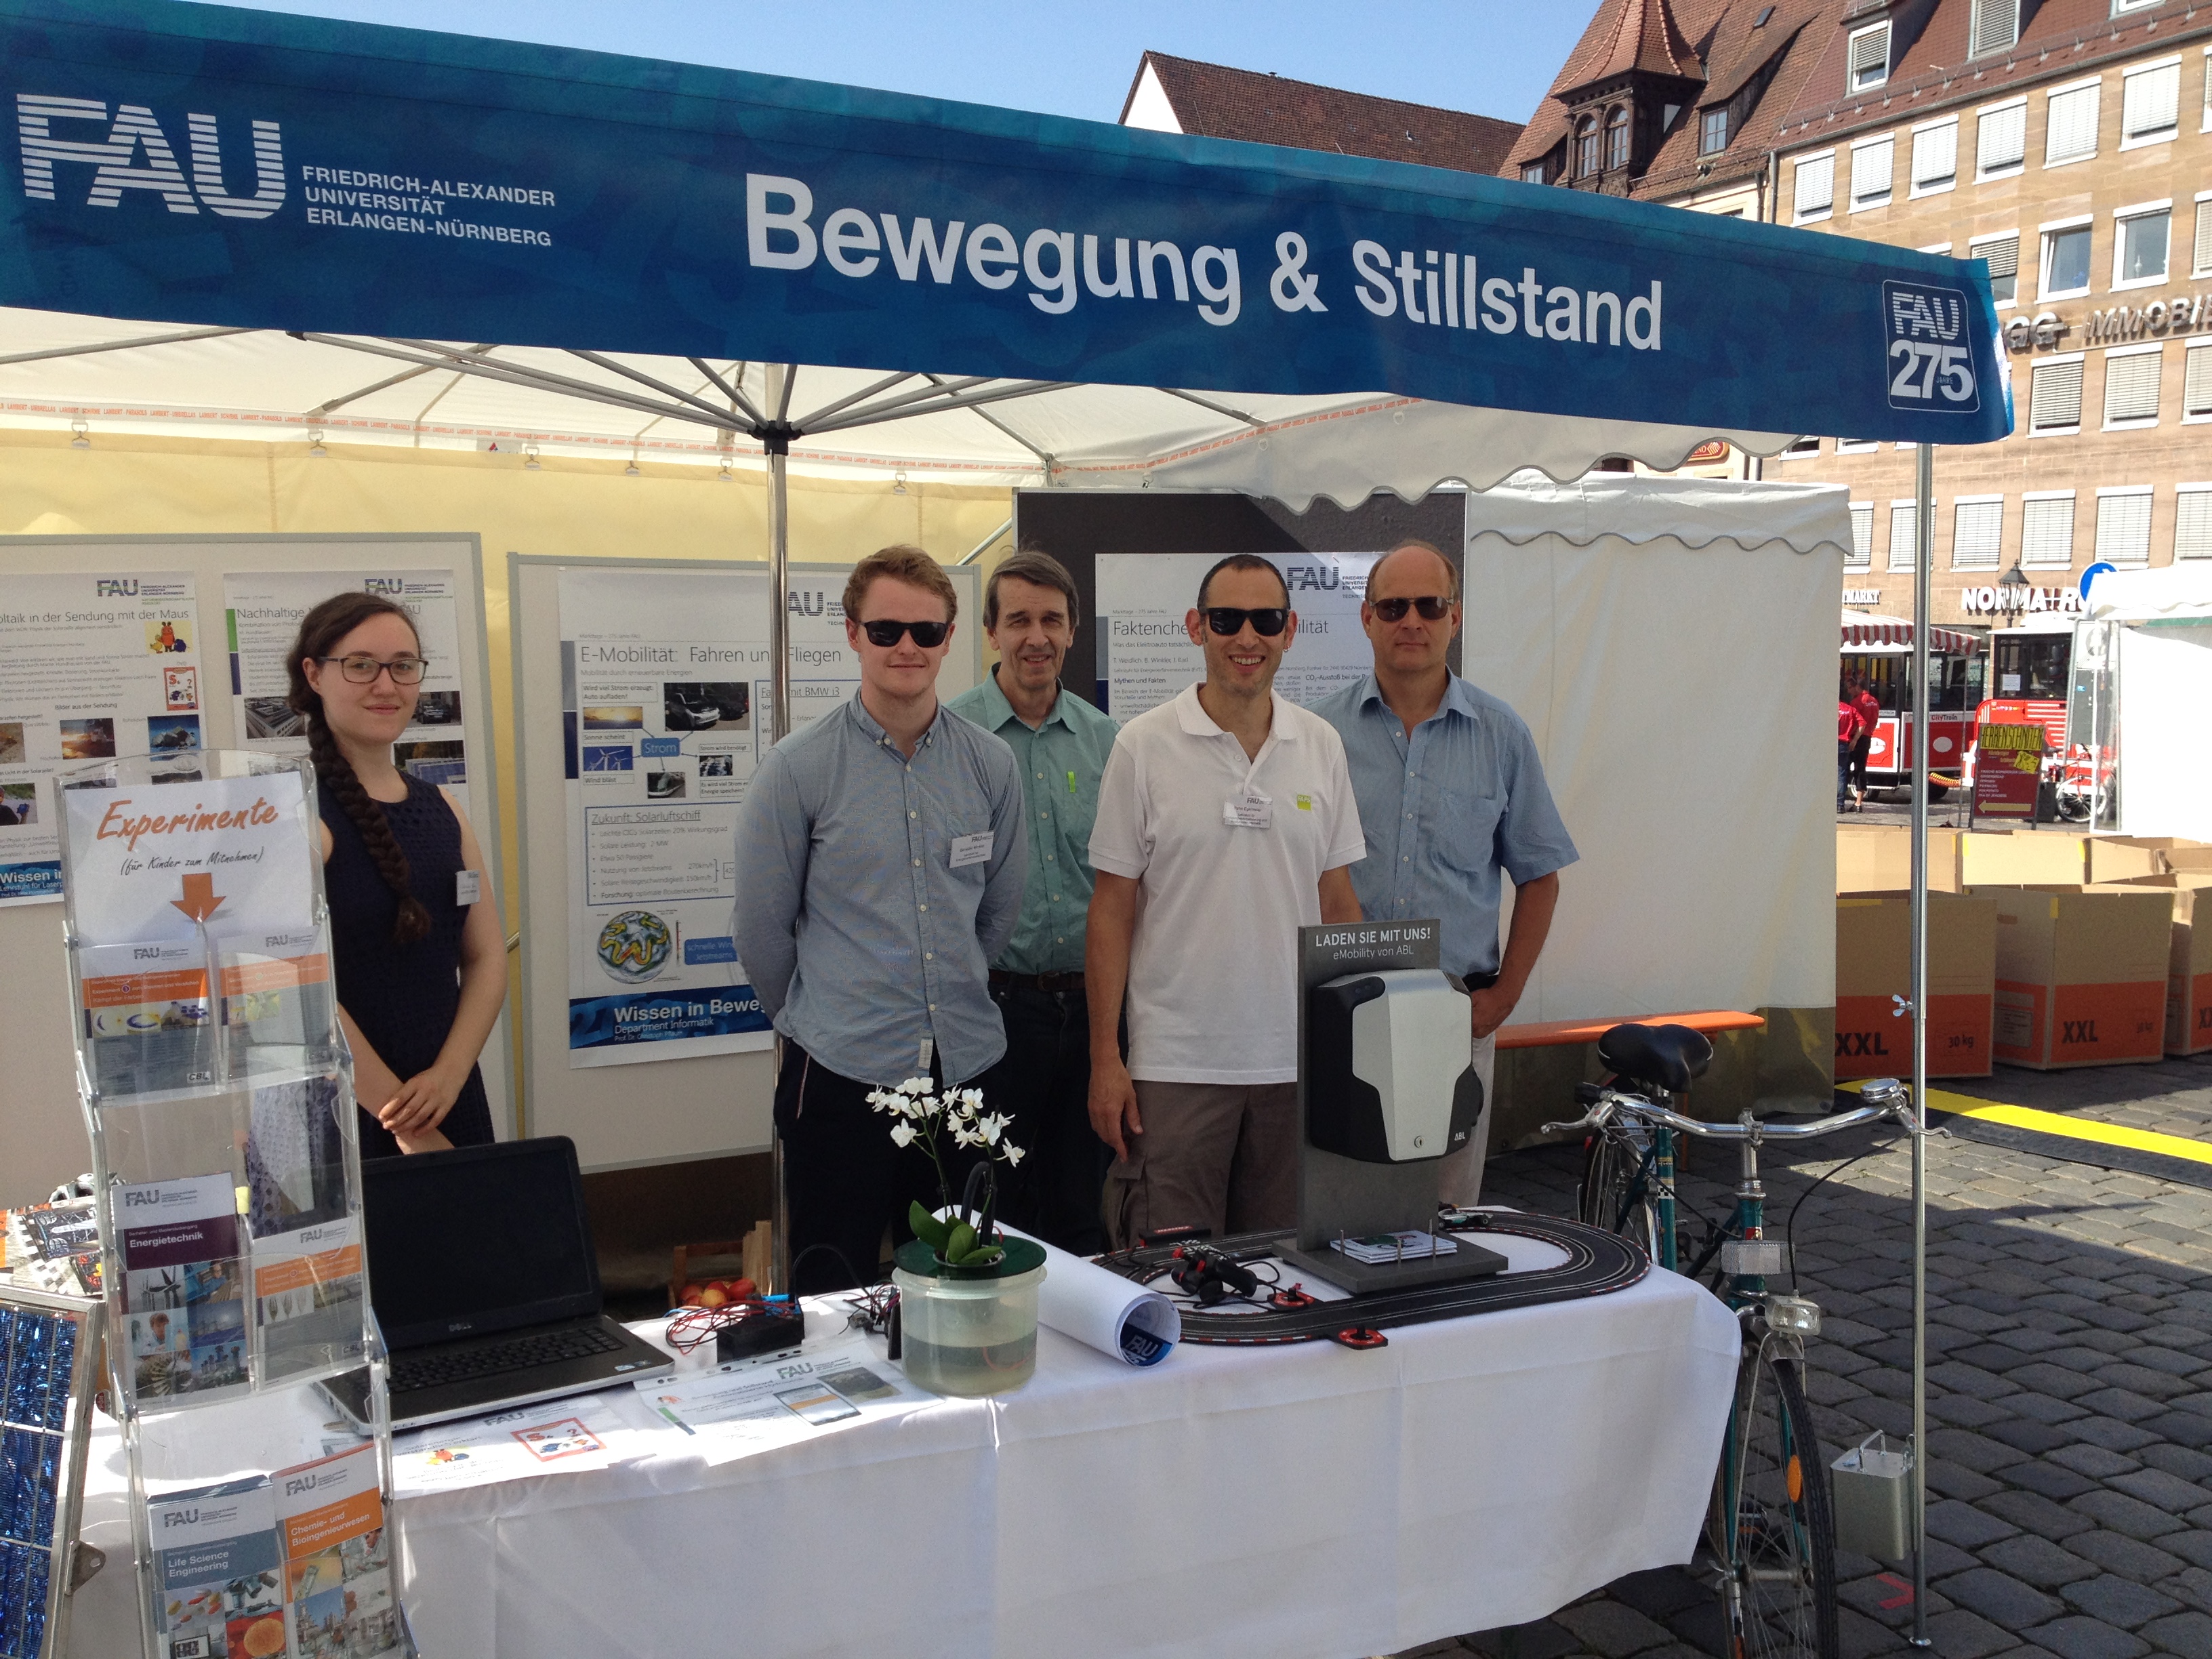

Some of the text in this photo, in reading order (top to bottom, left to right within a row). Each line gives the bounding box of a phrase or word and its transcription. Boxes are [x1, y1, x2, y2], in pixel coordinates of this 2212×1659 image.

[17, 94, 285, 218] FAU
[303, 166, 554, 207] FRIEDRICH-ALEXANDER
[306, 187, 445, 215] UNIVERSITÄT
[307, 208, 551, 247] ERLANGEN-NÜRNBERG
[747, 173, 1661, 350] Bewegung & Stillstand
[1893, 292, 1959, 340] FAU
[1889, 340, 1973, 401] 275
[365, 579, 402, 594] FAU
[1287, 567, 1339, 590] FAU
[97, 579, 138, 596] FAU
[788, 592, 823, 616] AU
[1961, 586, 2047, 610] NORMA
[43, 613, 62, 622] der
[66, 611, 114, 623] Sendung
[118, 611, 135, 620] mit
[139, 610, 157, 619] der
[160, 610, 189, 619] Maus
[237, 608, 304, 619] Nachhaltige
[581, 647, 678, 662] E-Mobilität:
[690, 647, 743, 662] Fahren
[805, 687, 829, 696] BMW
[644, 743, 676, 753] Strom
[96, 797, 279, 852] Experimente
[636, 810, 701, 822] Solarluftschiff
[148, 857, 181, 869] Kinder
[0, 872, 50, 883] Wissen
[266, 935, 288, 947] FAU
[1316, 928, 1431, 947] LADEN SIE MIT UNS!
[134, 947, 159, 959] FAU
[1333, 945, 1414, 960] eMobility von ABL
[614, 1005, 682, 1023] Wissen
[688, 1002, 703, 1016] in
[615, 1018, 714, 1035] Department Informatik
[2062, 1020, 2098, 1044] XXL
[1835, 1032, 1889, 1056] XXL
[1454, 1132, 1465, 1141] ABL
[125, 1190, 159, 1206] FAU
[129, 1231, 203, 1248] Energietechnik
[300, 1229, 322, 1243] FAU
[1126, 1334, 1158, 1356] FAU
[777, 1362, 814, 1379] FAU
[483, 1412, 525, 1426] FAU
[285, 1475, 316, 1496] FAU
[164, 1509, 199, 1528] FAU
[291, 1520, 327, 1536] Chemie-
[330, 1511, 345, 1523] und
[292, 1514, 370, 1546] Bioingenieurwesen
[169, 1552, 229, 1568] Life Science
[169, 1561, 228, 1577] Engineering
